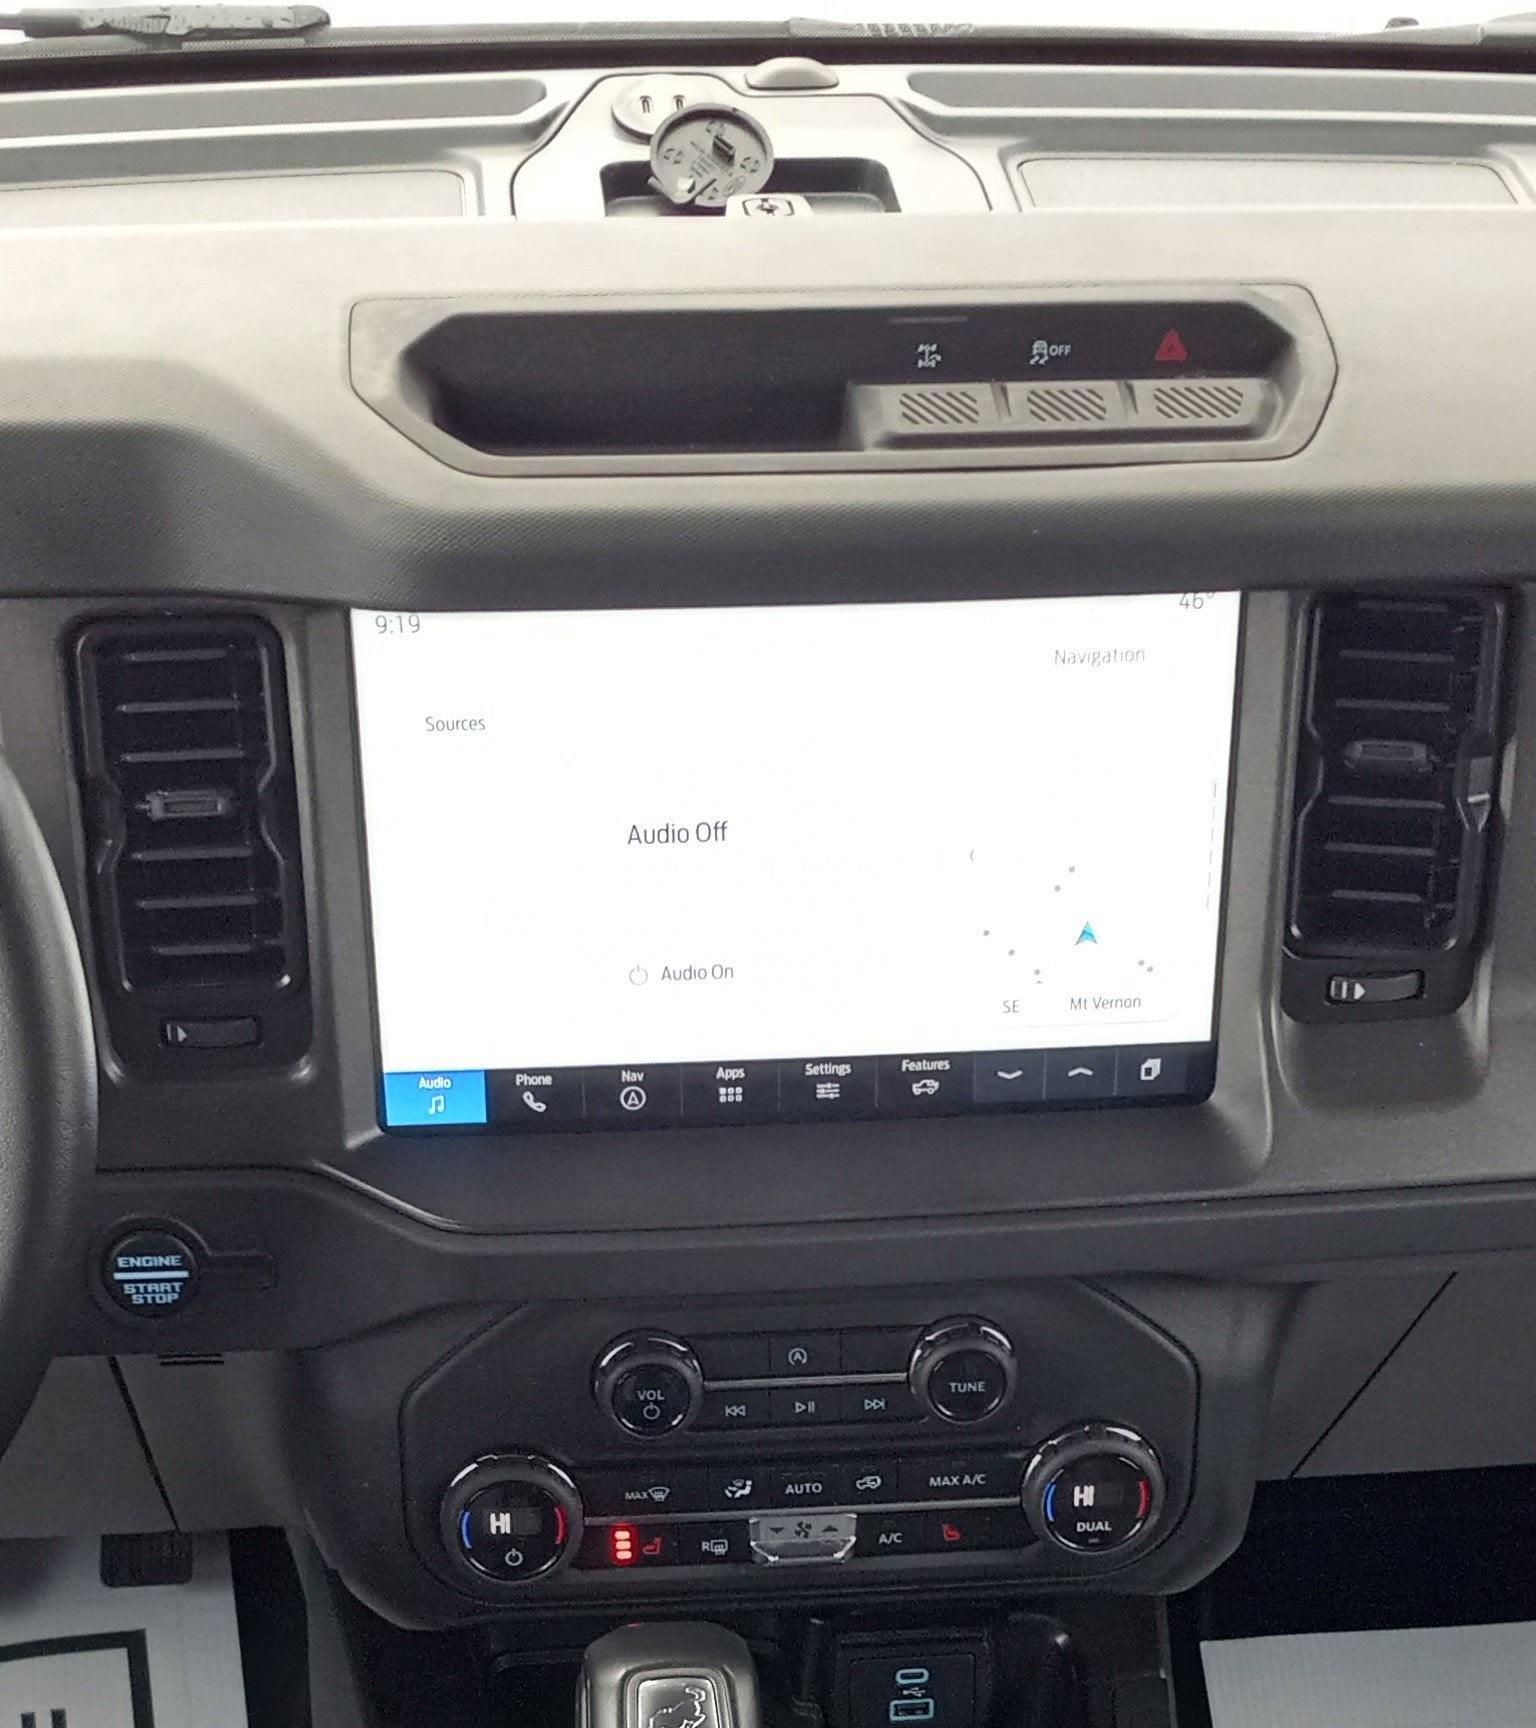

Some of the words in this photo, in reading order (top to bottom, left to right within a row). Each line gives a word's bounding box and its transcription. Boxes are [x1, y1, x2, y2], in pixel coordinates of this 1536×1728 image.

[1048, 344, 1071, 356] OFF
[375, 614, 421, 634] 9:19
[1054, 648, 1145, 667] Navigation
[425, 716, 486, 732] Sources
[627, 822, 690, 845] Audio
[695, 820, 728, 843] Off
[661, 964, 707, 981] Audio
[711, 963, 734, 980] On
[1002, 999, 1020, 1013] SE
[1069, 997, 1088, 1011] Mt
[1092, 996, 1142, 1010] Vernon
[804, 1062, 852, 1077] Settings
[901, 1059, 951, 1073] Features
[515, 1073, 553, 1087] Phone
[621, 1069, 645, 1083] Nav
[716, 1066, 746, 1081] Apps
[418, 1075, 452, 1090] Audio
[116, 1254, 183, 1268] ENGINE
[123, 1281, 184, 1295] START
[131, 1292, 180, 1305] STOP
[948, 1380, 987, 1393] TUNE
[636, 1389, 665, 1401] VOL
[928, 1474, 961, 1488] MAX
[962, 1473, 987, 1487] A/C
[624, 1490, 649, 1501] MAX
[784, 1482, 823, 1495] AUTO
[1072, 1485, 1095, 1508] HI
[489, 1512, 512, 1535] HI
[1076, 1520, 1113, 1534] DUAL
[878, 1532, 903, 1545] A/C
